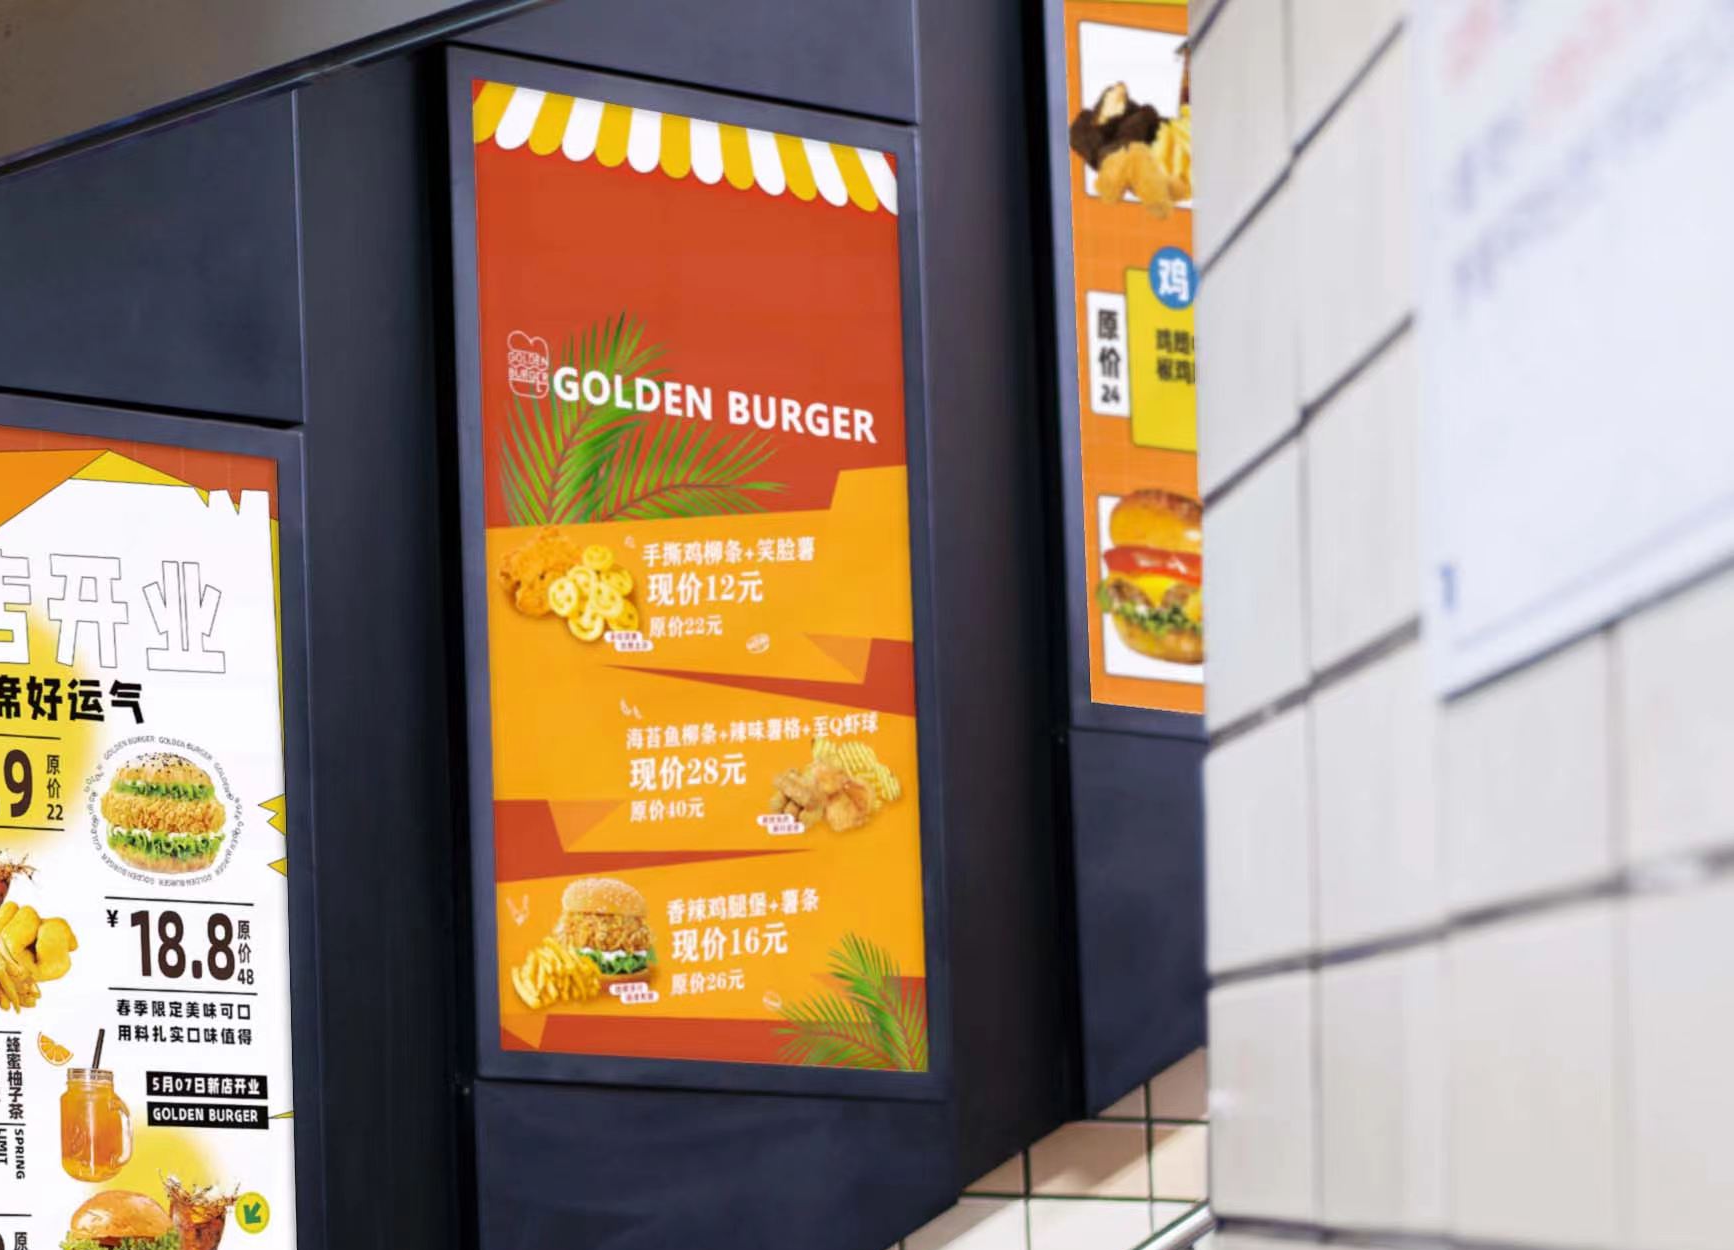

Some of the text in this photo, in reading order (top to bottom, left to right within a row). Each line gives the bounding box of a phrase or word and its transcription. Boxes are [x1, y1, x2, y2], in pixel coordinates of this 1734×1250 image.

[553, 366, 878, 444] GOLDEN BURGER
[647, 571, 763, 606] 现价12元
[649, 615, 723, 638] 原价22元
[629, 753, 747, 792] 现价28元
[630, 797, 705, 822] 原价40元
[672, 921, 788, 963] 现价16元
[670, 969, 746, 996] 原价26元
[116, 999, 252, 1020] 春季限定美味可口
[117, 1024, 253, 1046] 用料扎实口味值得
[6, 1036, 24, 1120] 蜂蜜柚子茶
[153, 1077, 261, 1097] 5月07日新店开业
[153, 1107, 259, 1125] GOLDEN BURGER
[15, 1128, 26, 1180] SPRING
